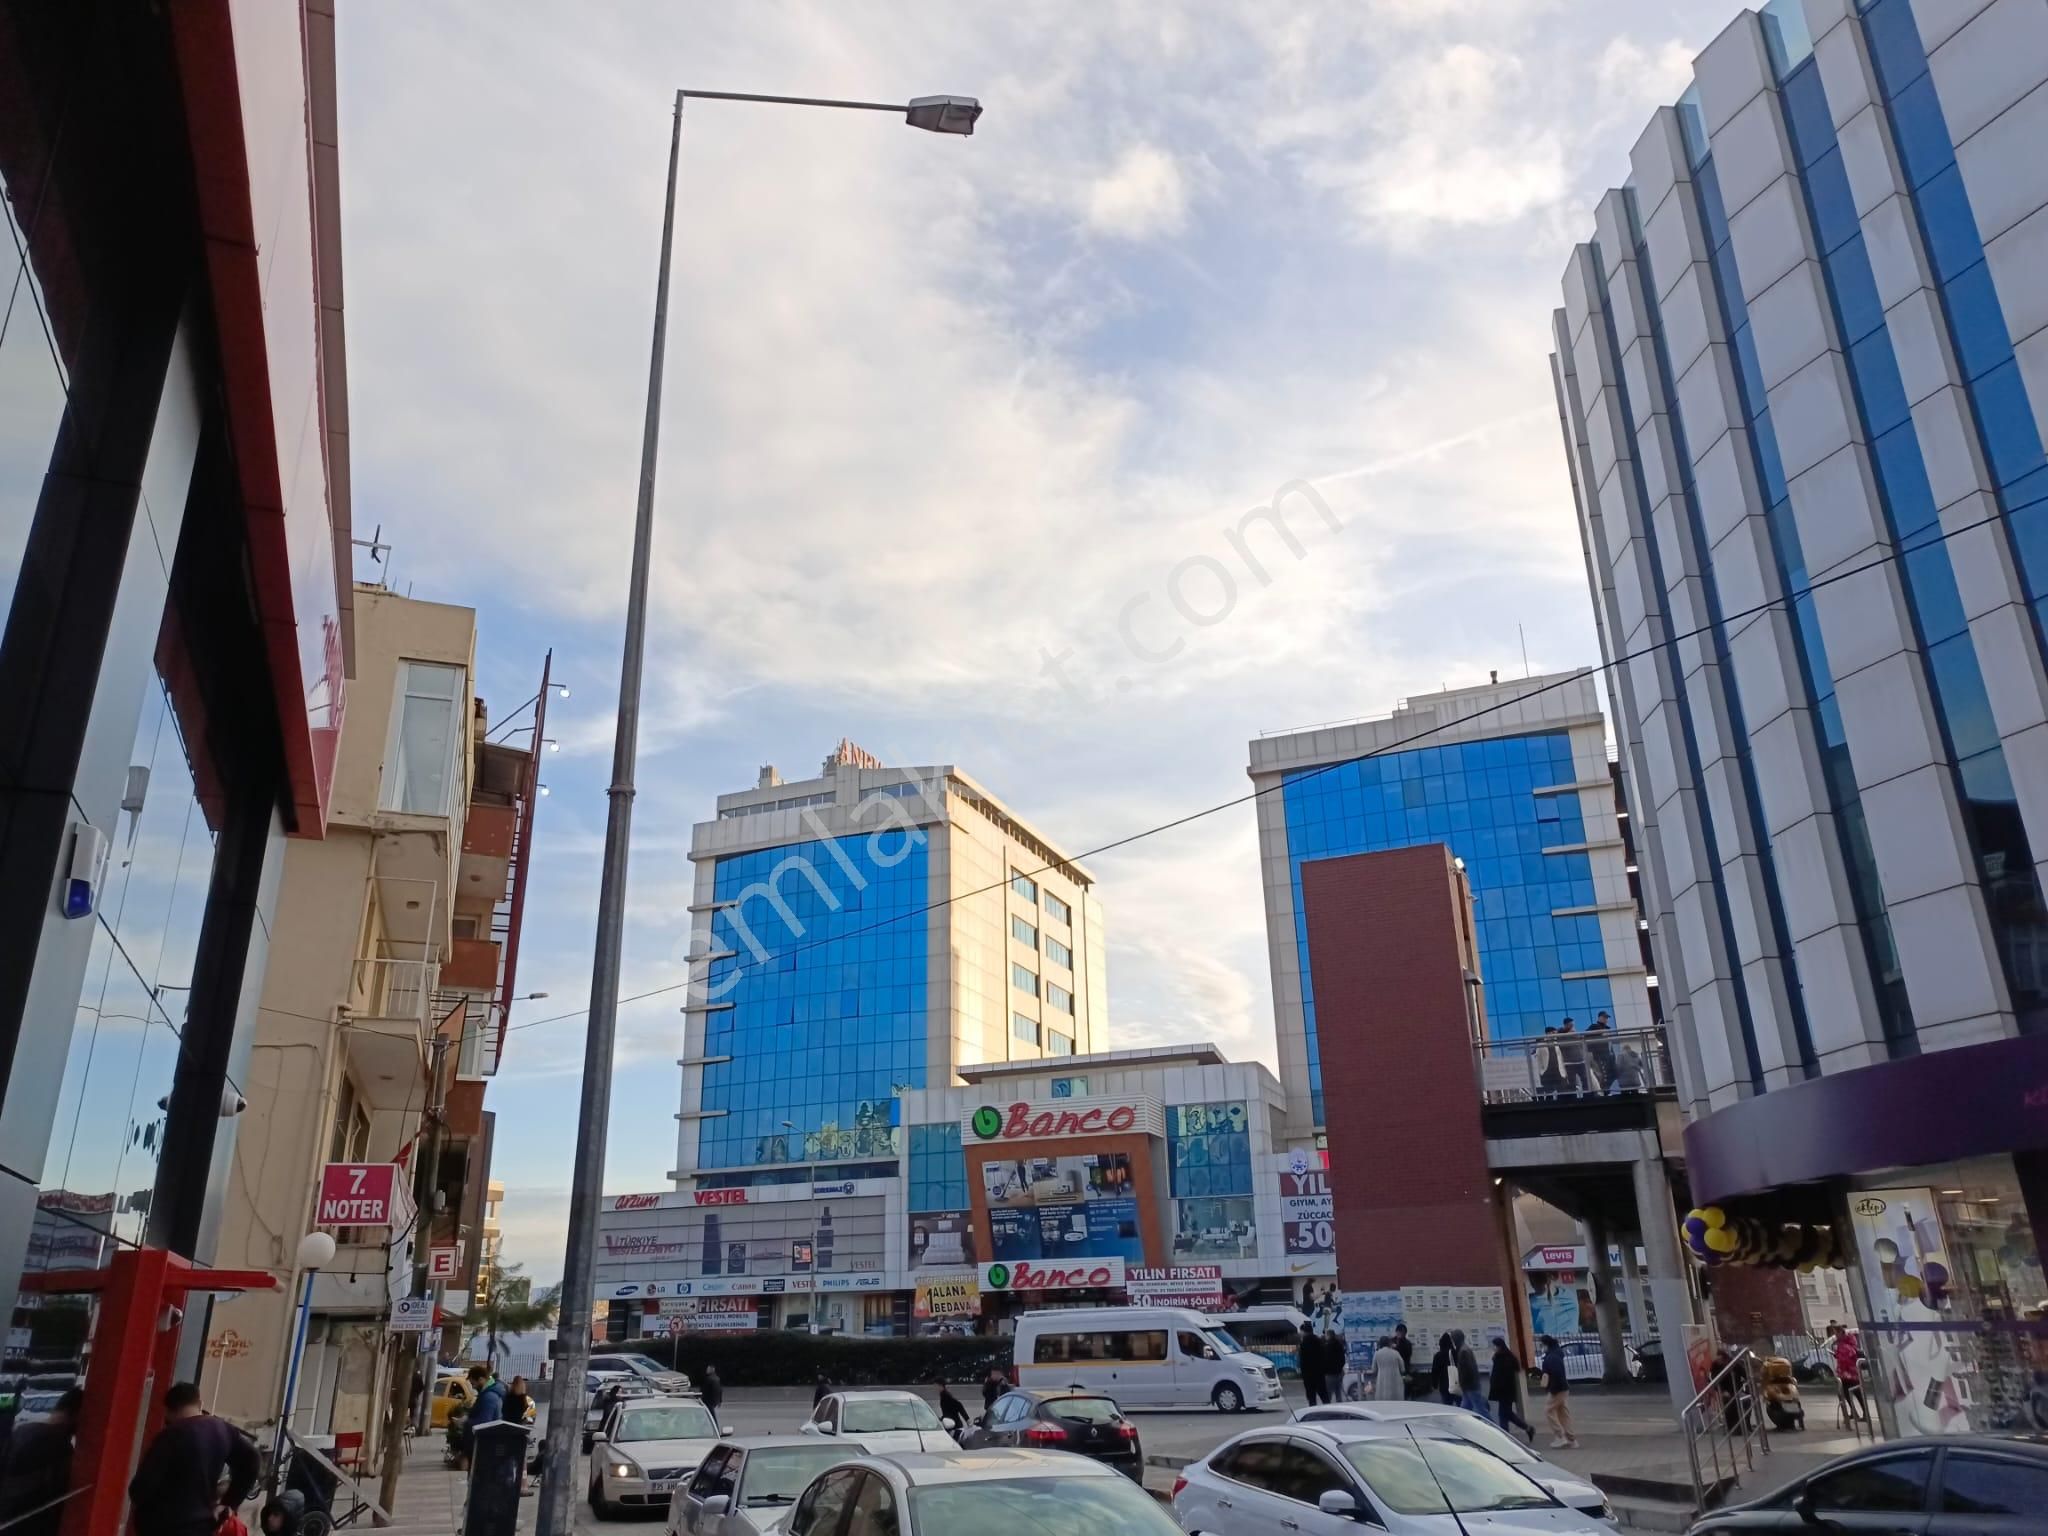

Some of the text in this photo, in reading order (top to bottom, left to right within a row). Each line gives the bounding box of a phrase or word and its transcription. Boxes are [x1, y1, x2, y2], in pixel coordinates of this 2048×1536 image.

[1003, 1102, 1135, 1139] Banco
[349, 1169, 367, 1195] 7.
[615, 1194, 660, 1210] arzum
[694, 1188, 748, 1205] VESTEL
[323, 1199, 384, 1219] NOTER
[434, 1254, 451, 1272] E
[1011, 1262, 1111, 1289] Banco
[1130, 1267, 1216, 1280] YILIN FIRSATI
[823, 1279, 850, 1287] PHILIPS
[856, 1278, 880, 1286] ASUS
[933, 1286, 967, 1297] ALANA
[699, 1298, 749, 1312] FIRSATI
[934, 1302, 972, 1313] BEDAVA
[1153, 1296, 1189, 1306] İNDİRİM
[1190, 1296, 1221, 1307] ŞÖLENİ
